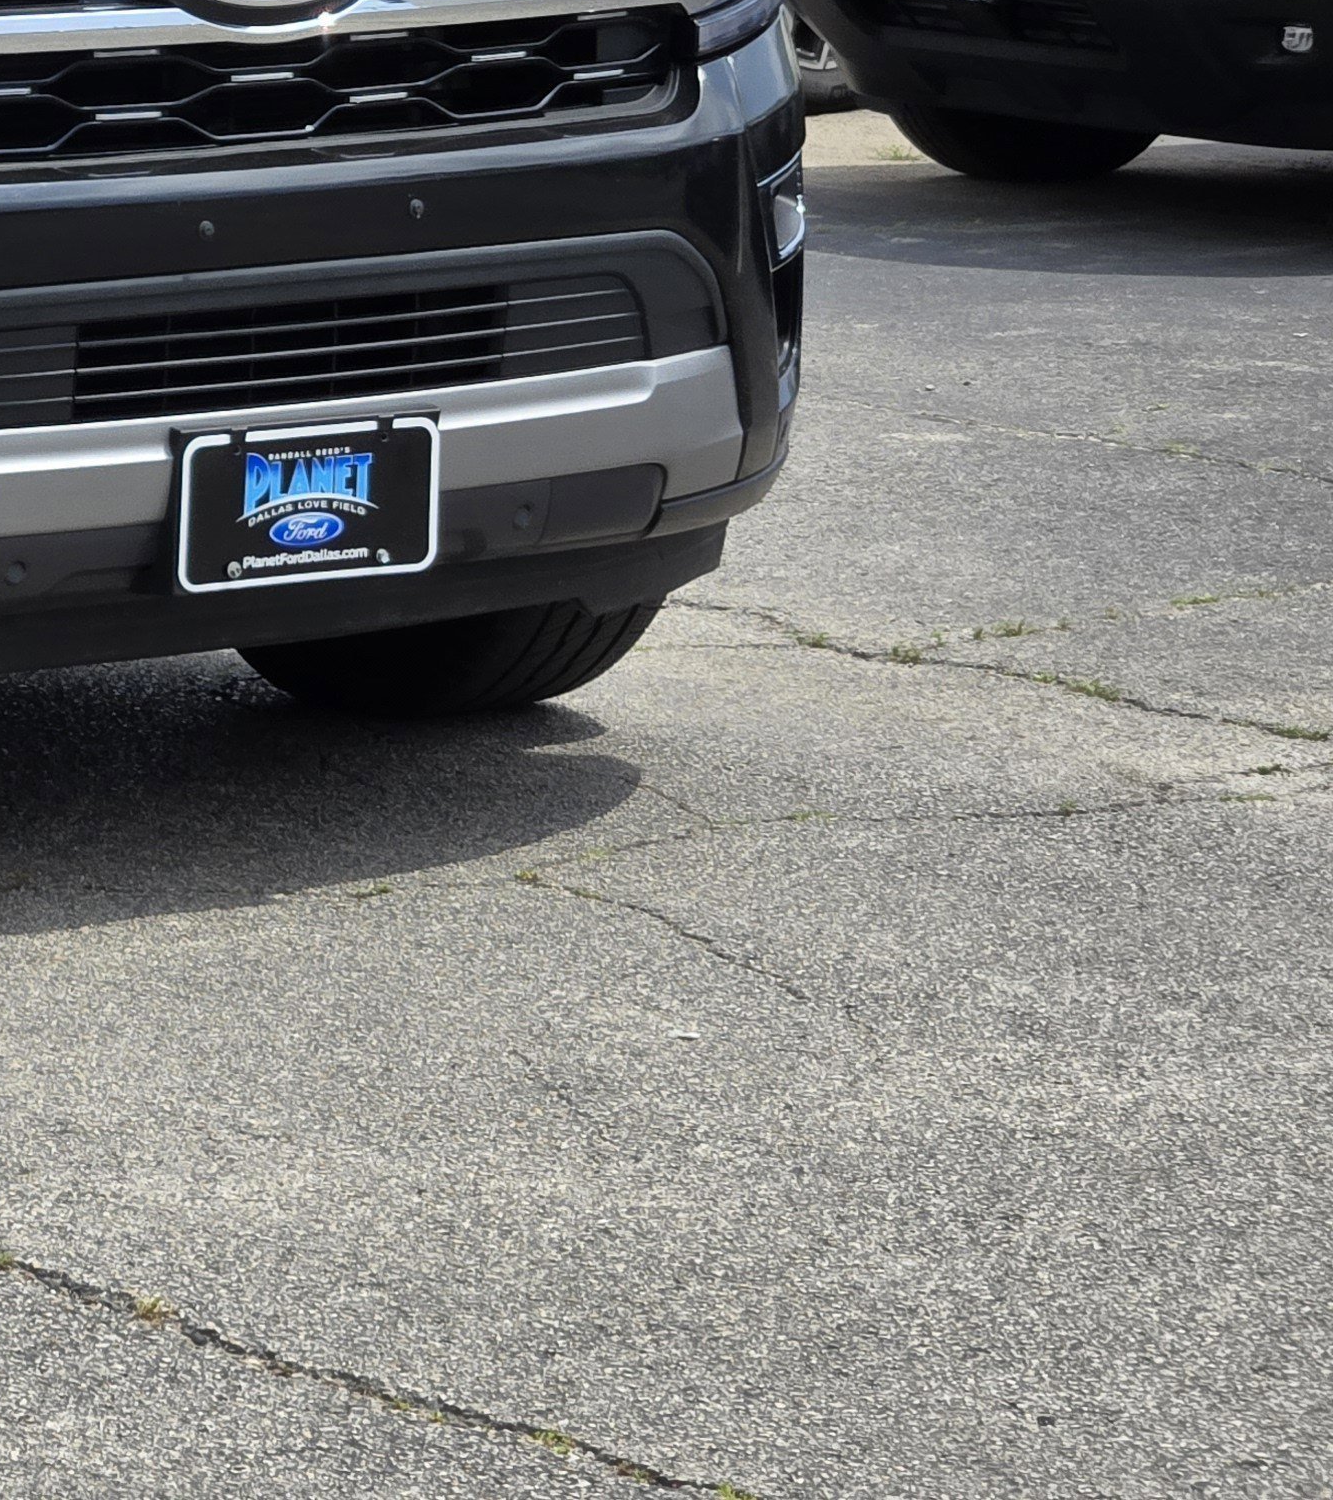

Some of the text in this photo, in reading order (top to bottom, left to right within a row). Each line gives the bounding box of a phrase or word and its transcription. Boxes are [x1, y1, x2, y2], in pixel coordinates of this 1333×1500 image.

[243, 451, 373, 516] PLANET
[247, 500, 368, 528] DALLAS LOVE FIELD
[283, 518, 329, 541] Ford
[243, 547, 368, 569] PlanetFordDallas.com
